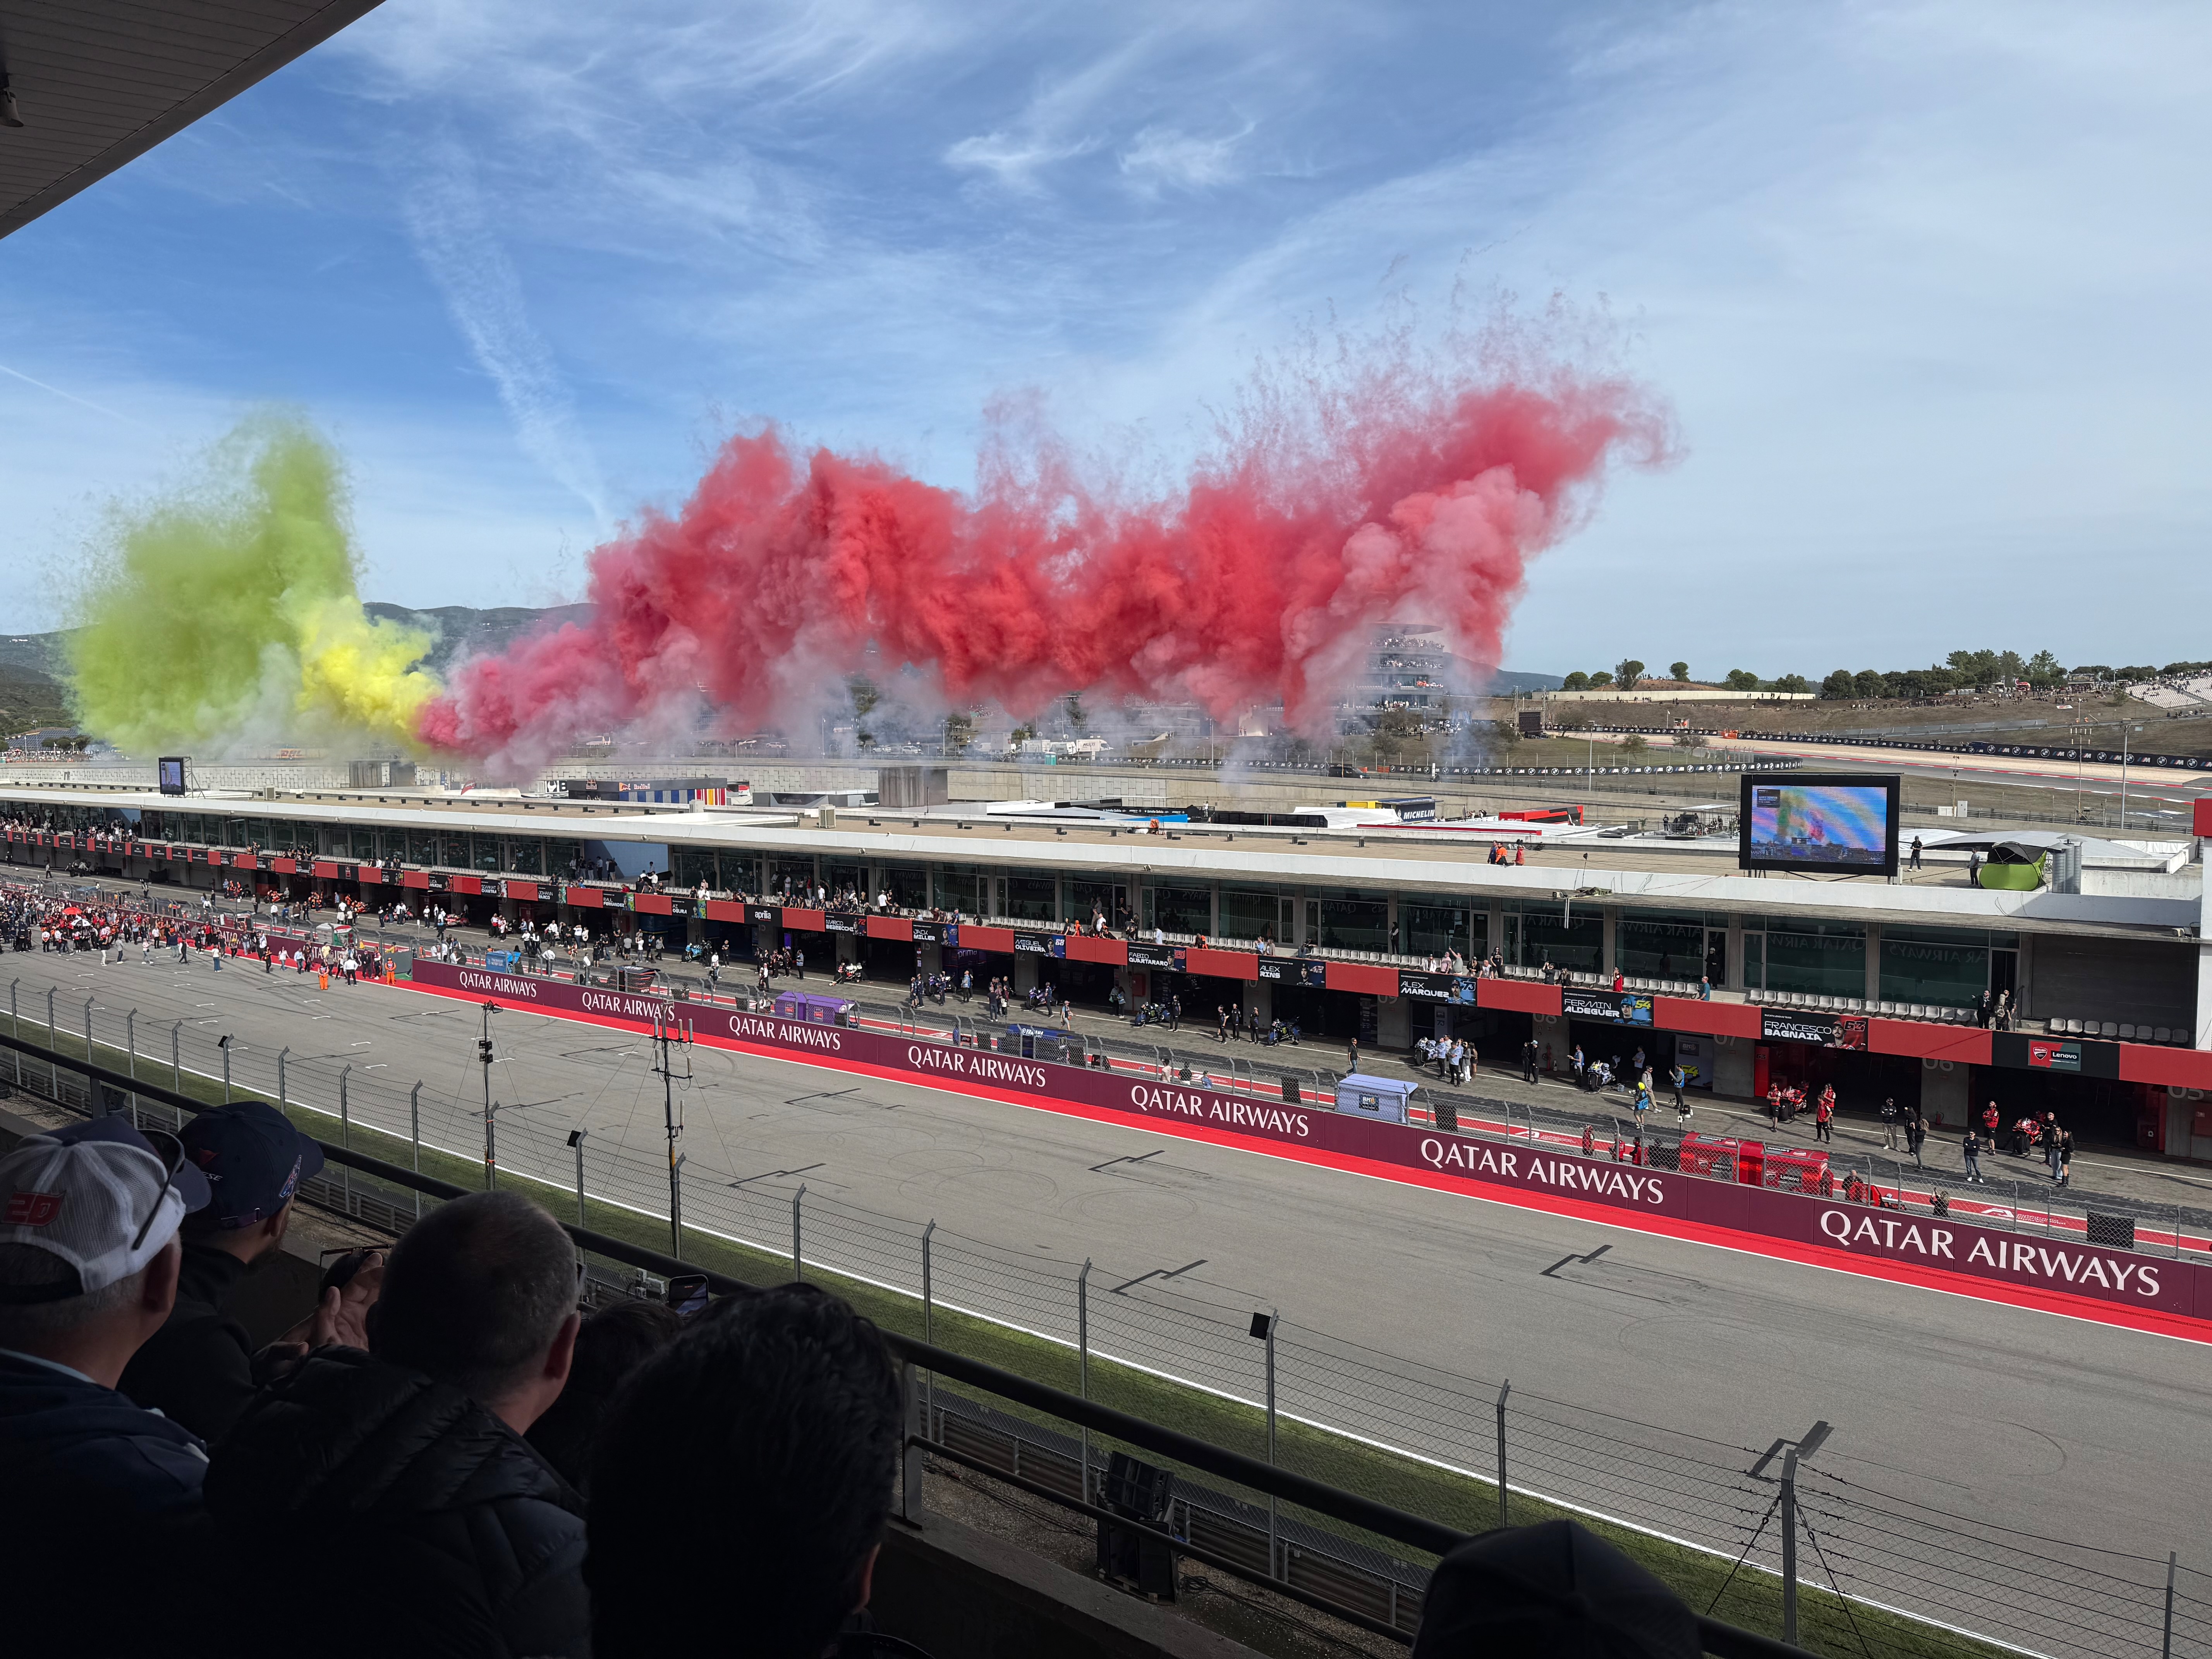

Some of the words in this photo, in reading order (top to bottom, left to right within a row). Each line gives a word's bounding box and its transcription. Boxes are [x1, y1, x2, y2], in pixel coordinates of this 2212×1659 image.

[1403, 809, 1435, 820] MICHELIN
[755, 910, 771, 920] aprilia
[1015, 944, 1046, 953] OLIVEIRA
[1129, 957, 1168, 967] QUARTARARO
[1260, 971, 1281, 979] RINS
[460, 971, 492, 990] QATAR
[494, 977, 537, 998] AIRWAYS
[1401, 981, 1424, 989] ALEX
[1462, 981, 1476, 992] 73
[1401, 987, 1449, 998] MARQUEZ
[582, 992, 621, 1012] QATAR
[1565, 999, 1611, 1010] FERMIN
[1635, 1000, 1651, 1009] 54
[1564, 1006, 1620, 1018] ALDEGUER
[1765, 1021, 1832, 1034] FRANCESCO
[1844, 1020, 1866, 1032] 63
[729, 1016, 775, 1039] QATAR
[779, 1024, 841, 1050] AIRWAYS
[1764, 1028, 1823, 1041] BAGNAIA
[908, 1046, 965, 1072] QATAR
[969, 1056, 1046, 1087] AIRWAYS
[1131, 1085, 1203, 1117] QATAR
[1209, 1099, 1309, 1137] AIRWAYS
[1421, 1139, 1518, 1178] QATAR
[1527, 1158, 1663, 1204] AIRWAYS
[1820, 1211, 1955, 1259] QATAR
[1967, 1237, 2160, 1296] AIRWAYS
